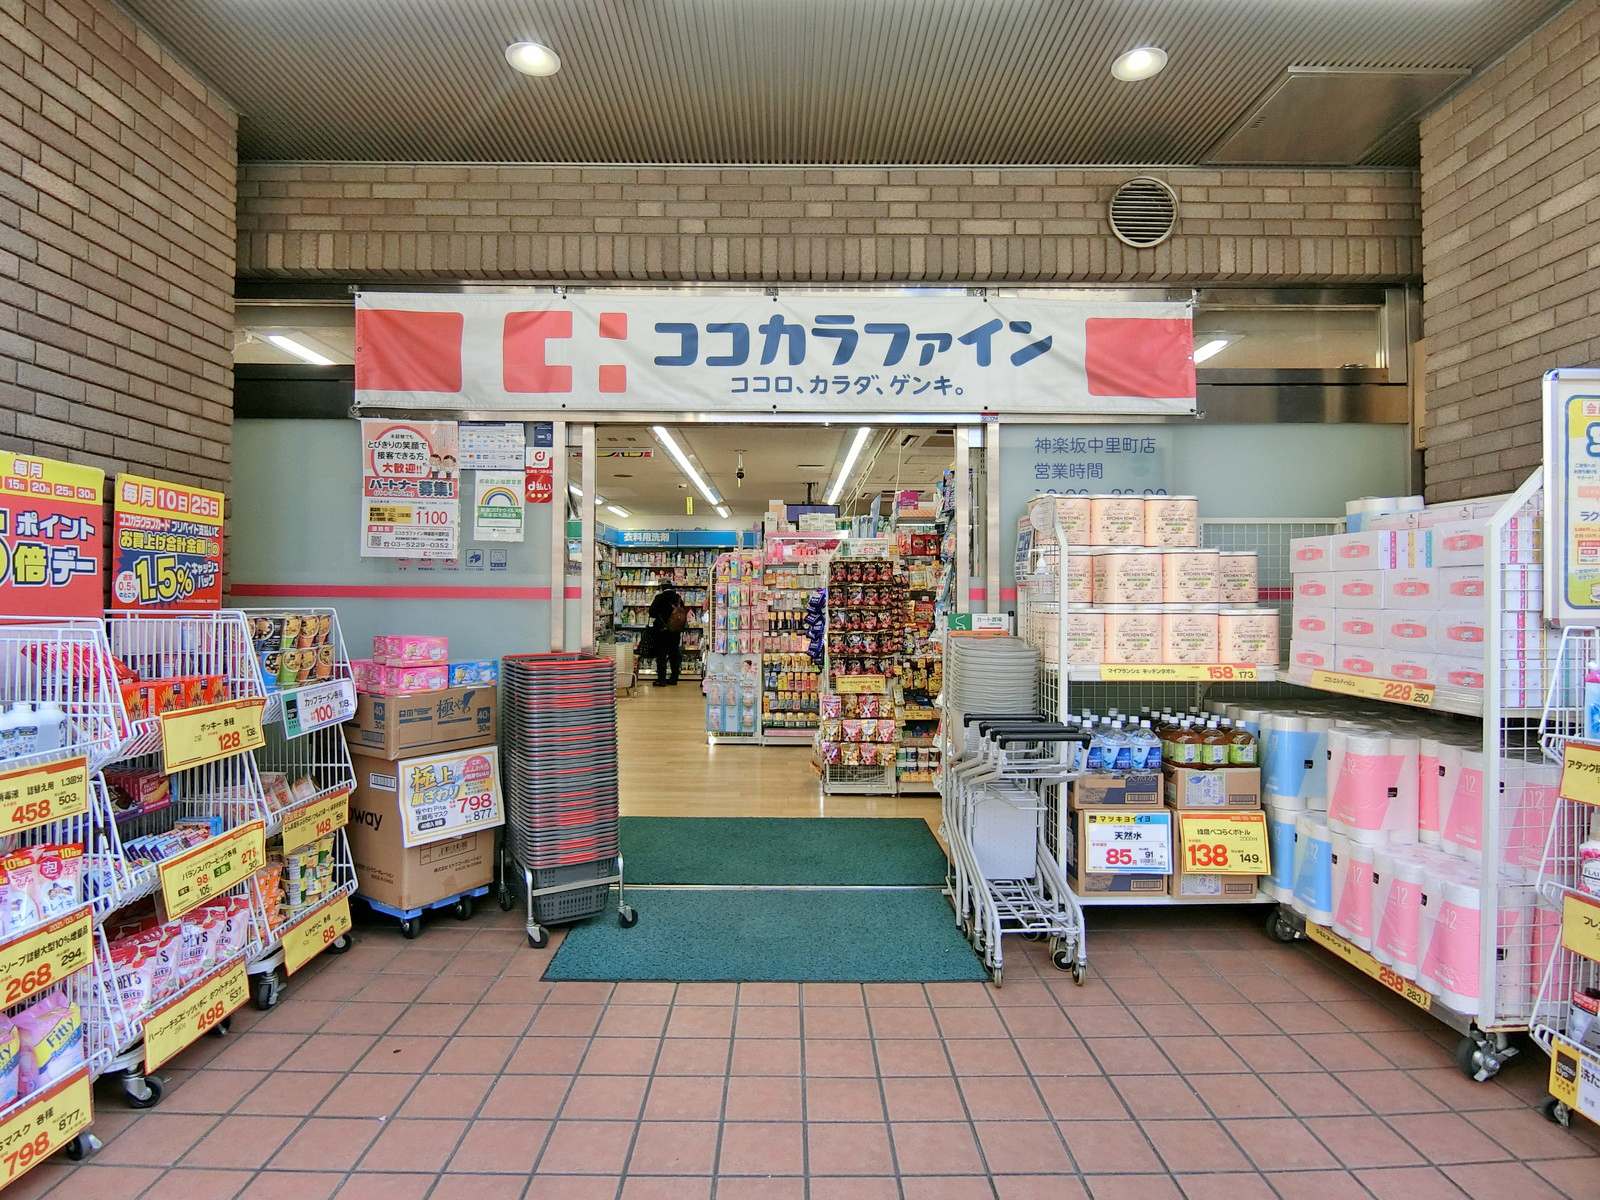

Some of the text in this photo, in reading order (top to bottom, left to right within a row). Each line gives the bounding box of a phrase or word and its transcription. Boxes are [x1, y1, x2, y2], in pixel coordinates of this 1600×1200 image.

[654, 314, 1053, 367] ココカラファイン
[730, 375, 963, 396] ココロ、カラダ、ゲンキ。
[367, 441, 427, 450] とびきりの笑顔で
[1034, 437, 1156, 454] 神楽坂中里町店
[14, 459, 43, 478] 毎月
[1034, 463, 1103, 480] 営業時間
[369, 479, 453, 497] パートナー 募集!
[528, 481, 552, 490] d払い
[122, 482, 219, 518] 毎月 10日 25日
[16, 510, 95, 542] ポイント
[416, 511, 448, 524] 1100
[120, 530, 206, 555] お買上げ合計金額
[624, 532, 670, 542] 衣料用洗剤
[192, 561, 219, 574] キャッシュ
[136, 556, 194, 601] 1.5%
[198, 574, 215, 588] バック
[1207, 666, 1234, 679] 158
[1238, 671, 1254, 679] 173
[1383, 683, 1412, 700] 228
[1413, 693, 1430, 703] 250
[315, 704, 333, 722] 100
[201, 722, 222, 732] ポッキー
[218, 731, 241, 751] 128
[1464, 774, 1476, 792] 12
[58, 792, 77, 805] 503
[411, 785, 460, 807] 肌ざわり
[457, 793, 492, 813] 798
[12, 799, 50, 824] 458
[474, 808, 492, 820] 877
[316, 818, 331, 836] 148
[1114, 831, 1142, 840] 天然水
[1106, 848, 1132, 865] 85
[1188, 844, 1228, 866] 138
[1240, 854, 1260, 863] 149
[42, 860, 58, 874] 泡
[196, 874, 209, 886] 98
[200, 884, 210, 896] 105
[1396, 886, 1408, 905] 12
[1446, 908, 1457, 930] 12
[323, 925, 335, 943] 88
[61, 948, 82, 966] 294
[6, 962, 52, 1004] 268
[1378, 966, 1404, 992] 258
[229, 987, 242, 1001] 537
[1406, 988, 1422, 1003] 283
[197, 1000, 224, 1030] 498
[46, 1017, 74, 1048] Fitty
[59, 1108, 80, 1131] 877
[4, 1130, 50, 1177] 798
